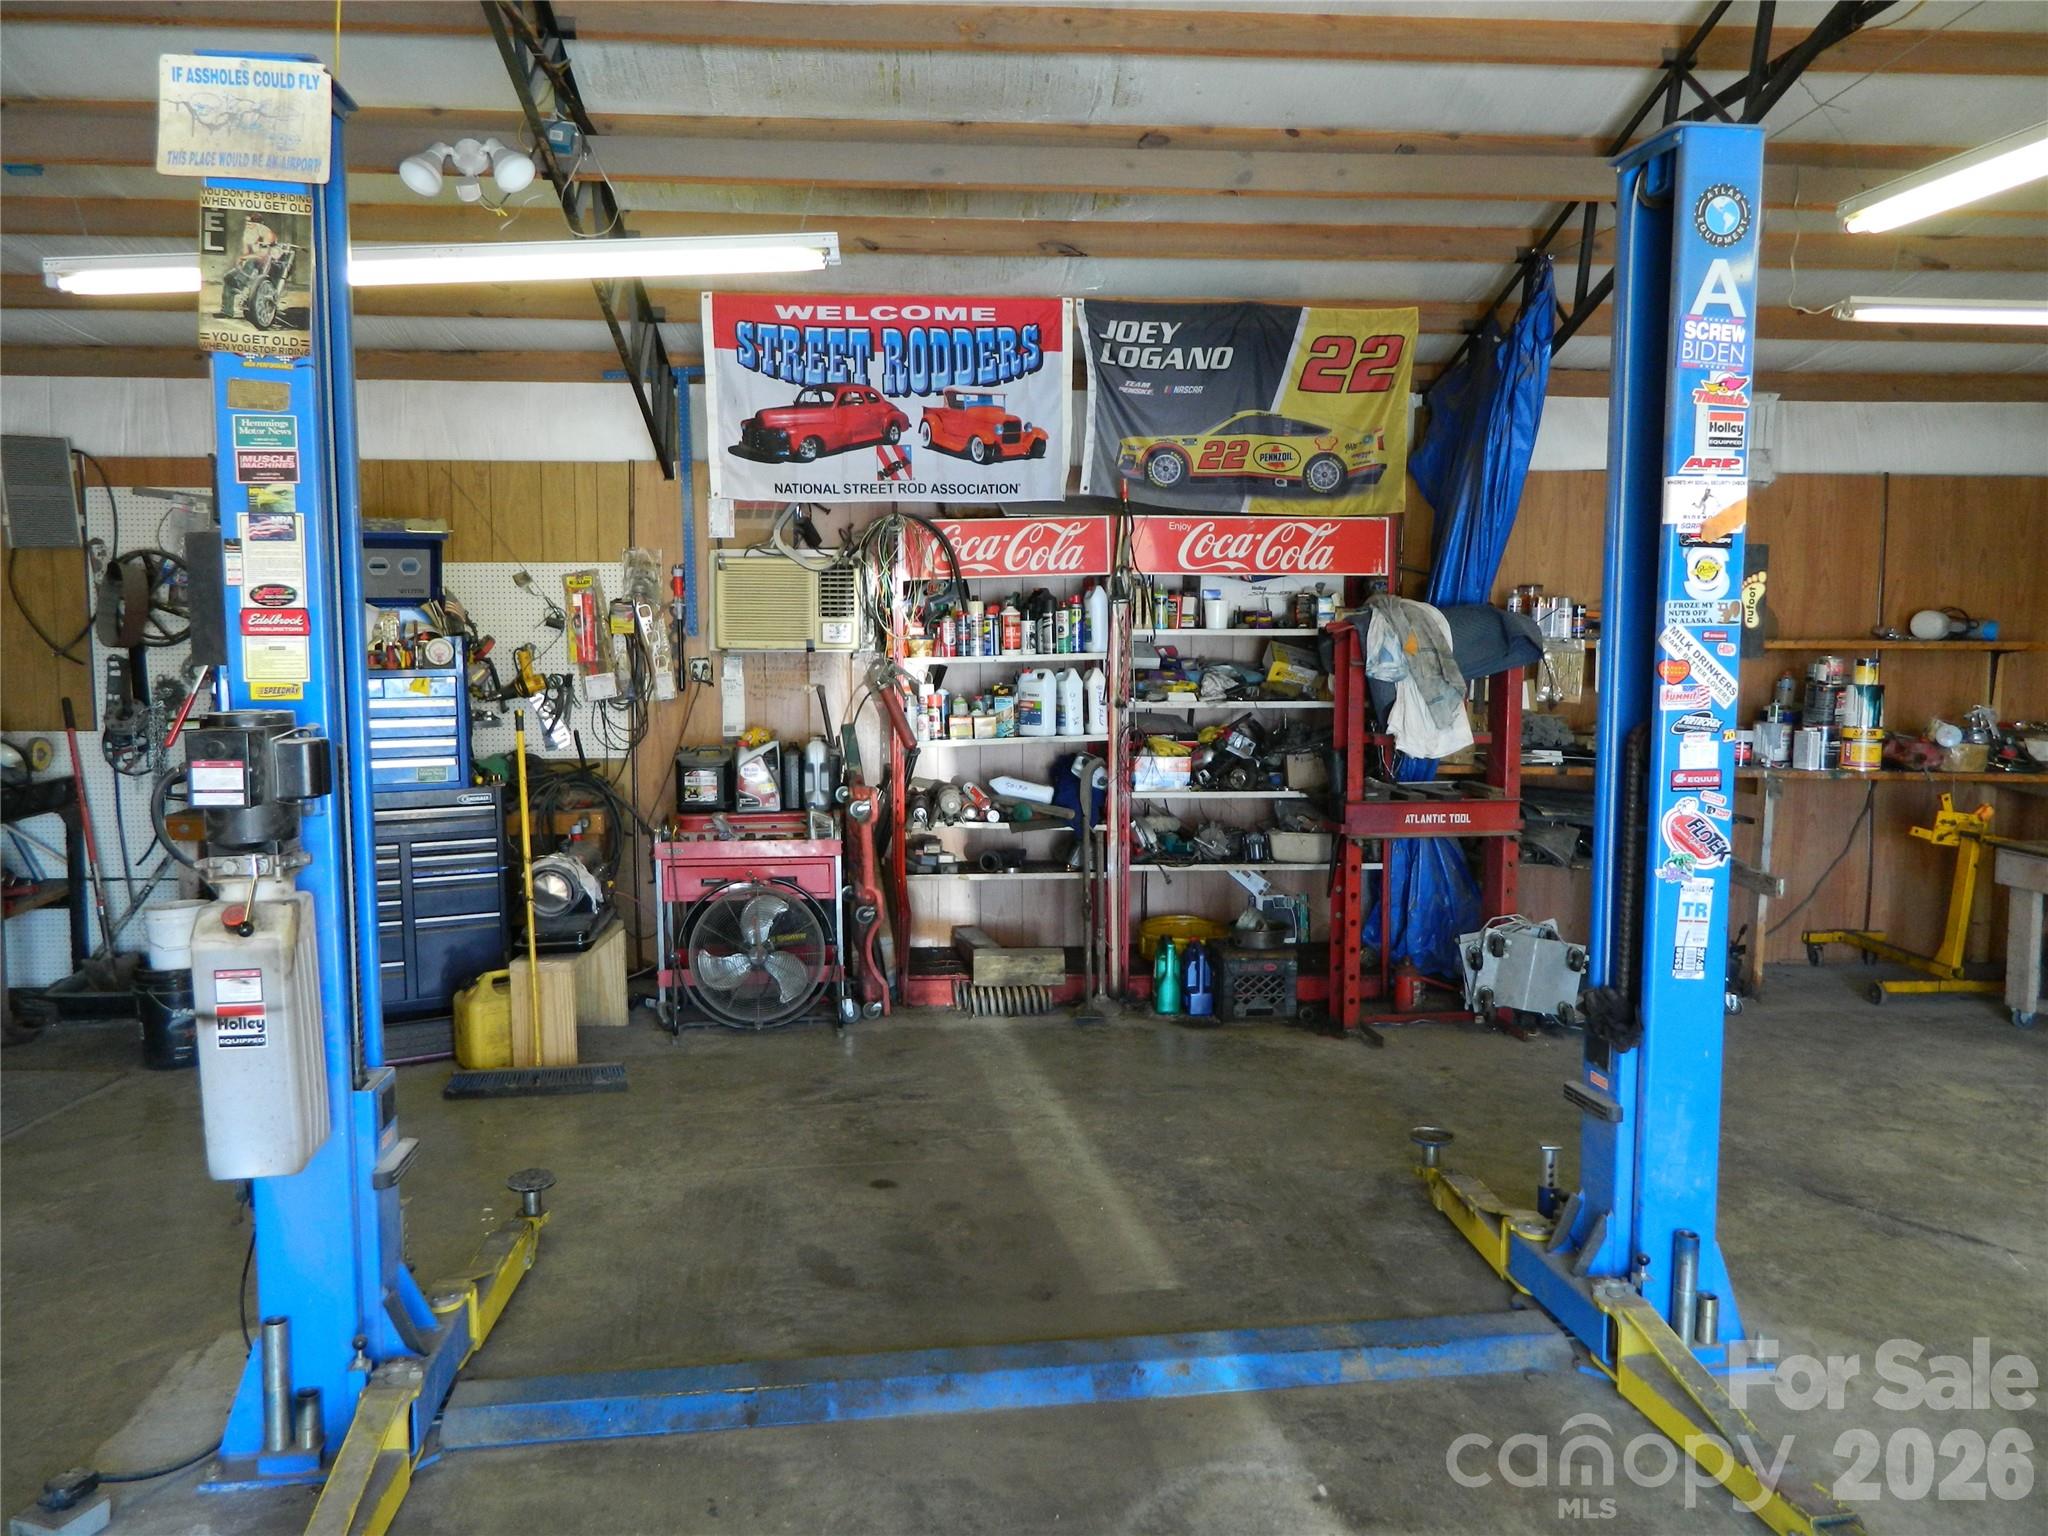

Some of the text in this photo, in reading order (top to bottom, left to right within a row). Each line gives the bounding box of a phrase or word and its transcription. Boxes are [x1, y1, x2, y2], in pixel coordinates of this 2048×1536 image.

[171, 66, 320, 90] IF ASSHOLES COULD FLY
[167, 151, 187, 166] THIS
[189, 151, 216, 167] PLACE
[218, 152, 249, 168] WOULD
[251, 153, 263, 168] BE
[265, 155, 277, 170] AN
[202, 188, 312, 203] YOU DON'T STOP RIDING
[1707, 187, 1741, 201] ATLAS
[201, 196, 312, 213] WHEN YOU GET OLD
[1697, 217, 1747, 244] EQUIPMENT
[1689, 258, 1747, 317] A
[774, 305, 996, 322] WELCOME
[212, 332, 299, 347] YOU GET OLD
[1099, 320, 1183, 344] JOEY
[1684, 320, 1746, 343] SCREW
[201, 342, 311, 357] WHEN YOU STOP RIDING
[1100, 343, 1234, 370] LOGANO
[1681, 340, 1745, 363] BIDEN
[735, 320, 1044, 398] STREET RODDERS
[1297, 335, 1406, 394] 22
[1124, 380, 1151, 389] TEAM
[1173, 385, 1204, 394] NASCAR
[239, 426, 291, 435] Motor News
[241, 418, 289, 429] Hemmings
[1708, 421, 1744, 436] Holley
[242, 455, 295, 463] MUSCLE
[1197, 439, 1250, 470] 22
[1259, 451, 1293, 462] PENNZOIL
[1685, 457, 1740, 468] ARP
[774, 482, 1017, 495] NATIONAL STREET ROD ASSOCIATION
[1169, 521, 1192, 532] Enjoy
[925, 521, 1092, 574] Coca-Cola
[1177, 521, 1343, 571] Coca-Cola
[1746, 586, 1756, 623] nufoot
[248, 613, 304, 625] Edelbrock
[1663, 634, 1683, 653] MAKE
[1682, 652, 1707, 677] BETTER
[1706, 677, 1731, 702] LOVERS
[1669, 627, 1693, 651] MILK
[1692, 650, 1737, 696] DRINKERS
[263, 687, 300, 696] SPEEDWAY
[1664, 689, 1697, 700] Summit
[1688, 775, 1720, 783] EQUUS
[1404, 812, 1471, 824] ATLANTIC TOOL
[1686, 818, 1731, 862] FLOTEK
[1682, 901, 1708, 917] TR
[217, 1016, 266, 1033] Holley
[219, 1037, 265, 1045] EQUIPPED
